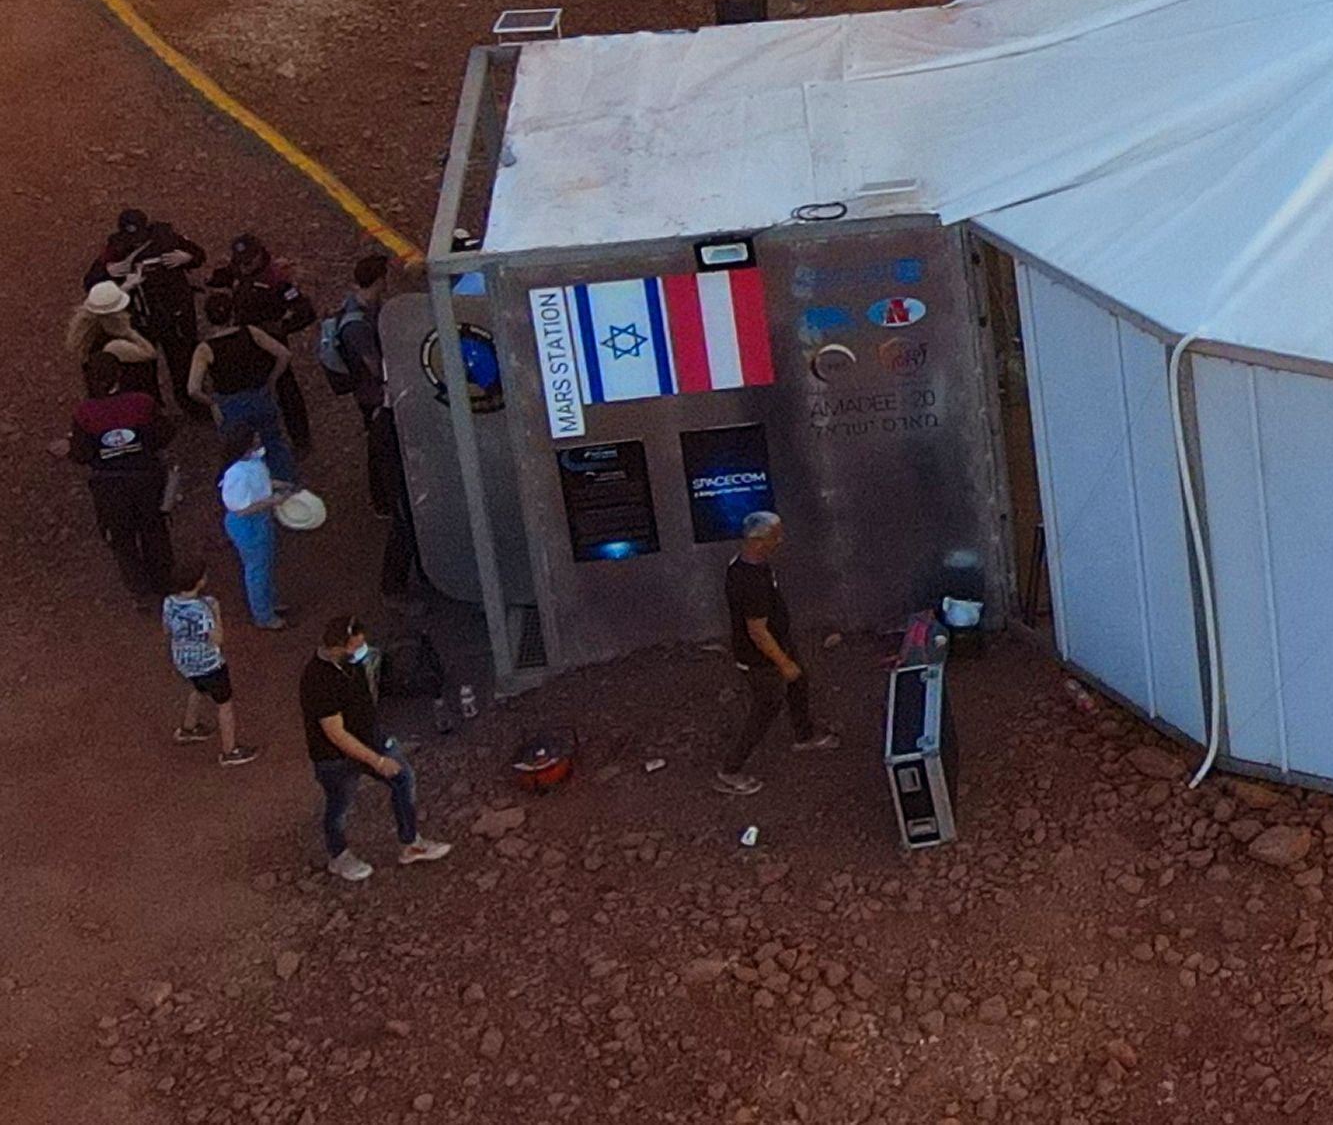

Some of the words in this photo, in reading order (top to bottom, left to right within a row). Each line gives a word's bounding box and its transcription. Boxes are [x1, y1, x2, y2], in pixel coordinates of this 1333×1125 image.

[538, 293, 569, 374] STATION
[552, 379, 578, 433] MARS
[811, 394, 898, 417] AMADEE
[692, 472, 766, 490] SPACECOM
